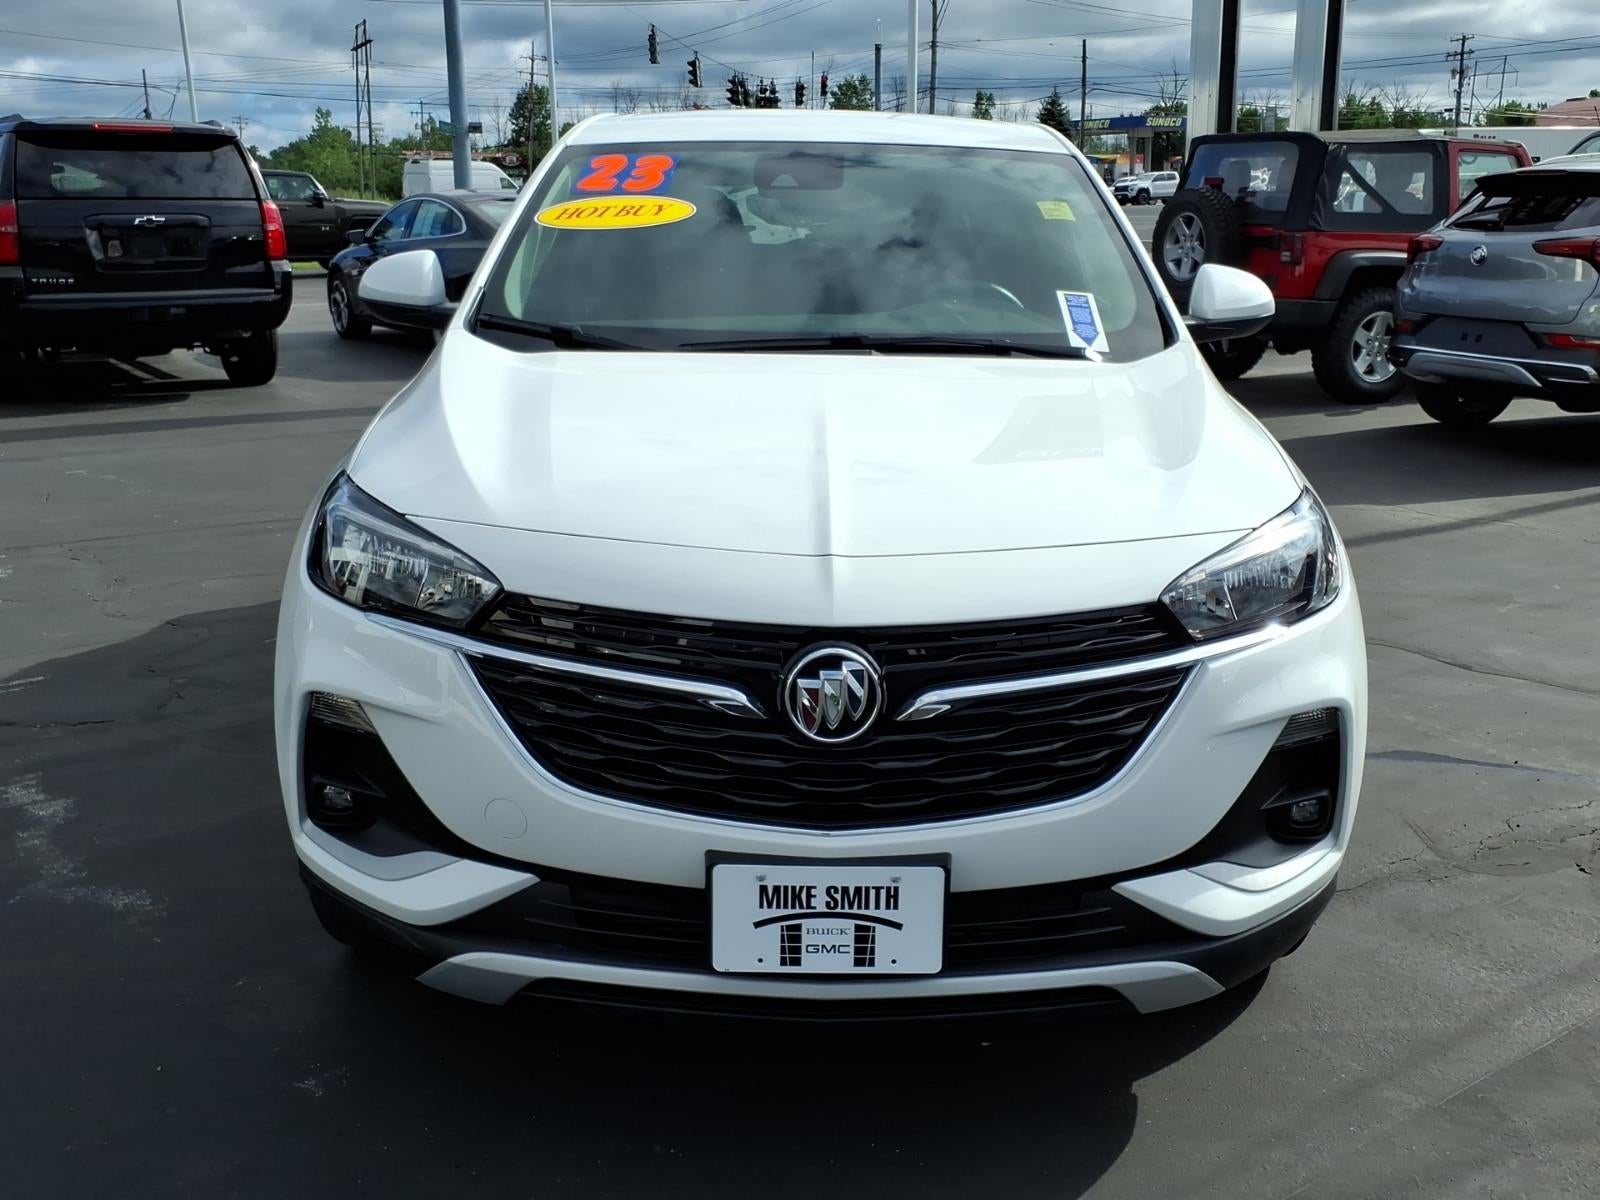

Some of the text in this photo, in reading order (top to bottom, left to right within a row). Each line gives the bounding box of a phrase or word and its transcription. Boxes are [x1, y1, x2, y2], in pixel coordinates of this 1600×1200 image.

[1145, 116, 1182, 127] SUNOCO
[576, 153, 673, 192] 23
[554, 203, 675, 220] HOT BUY
[758, 884, 900, 911] MIKE SMITH
[806, 927, 850, 936] BUICK
[805, 943, 850, 954] GMC
